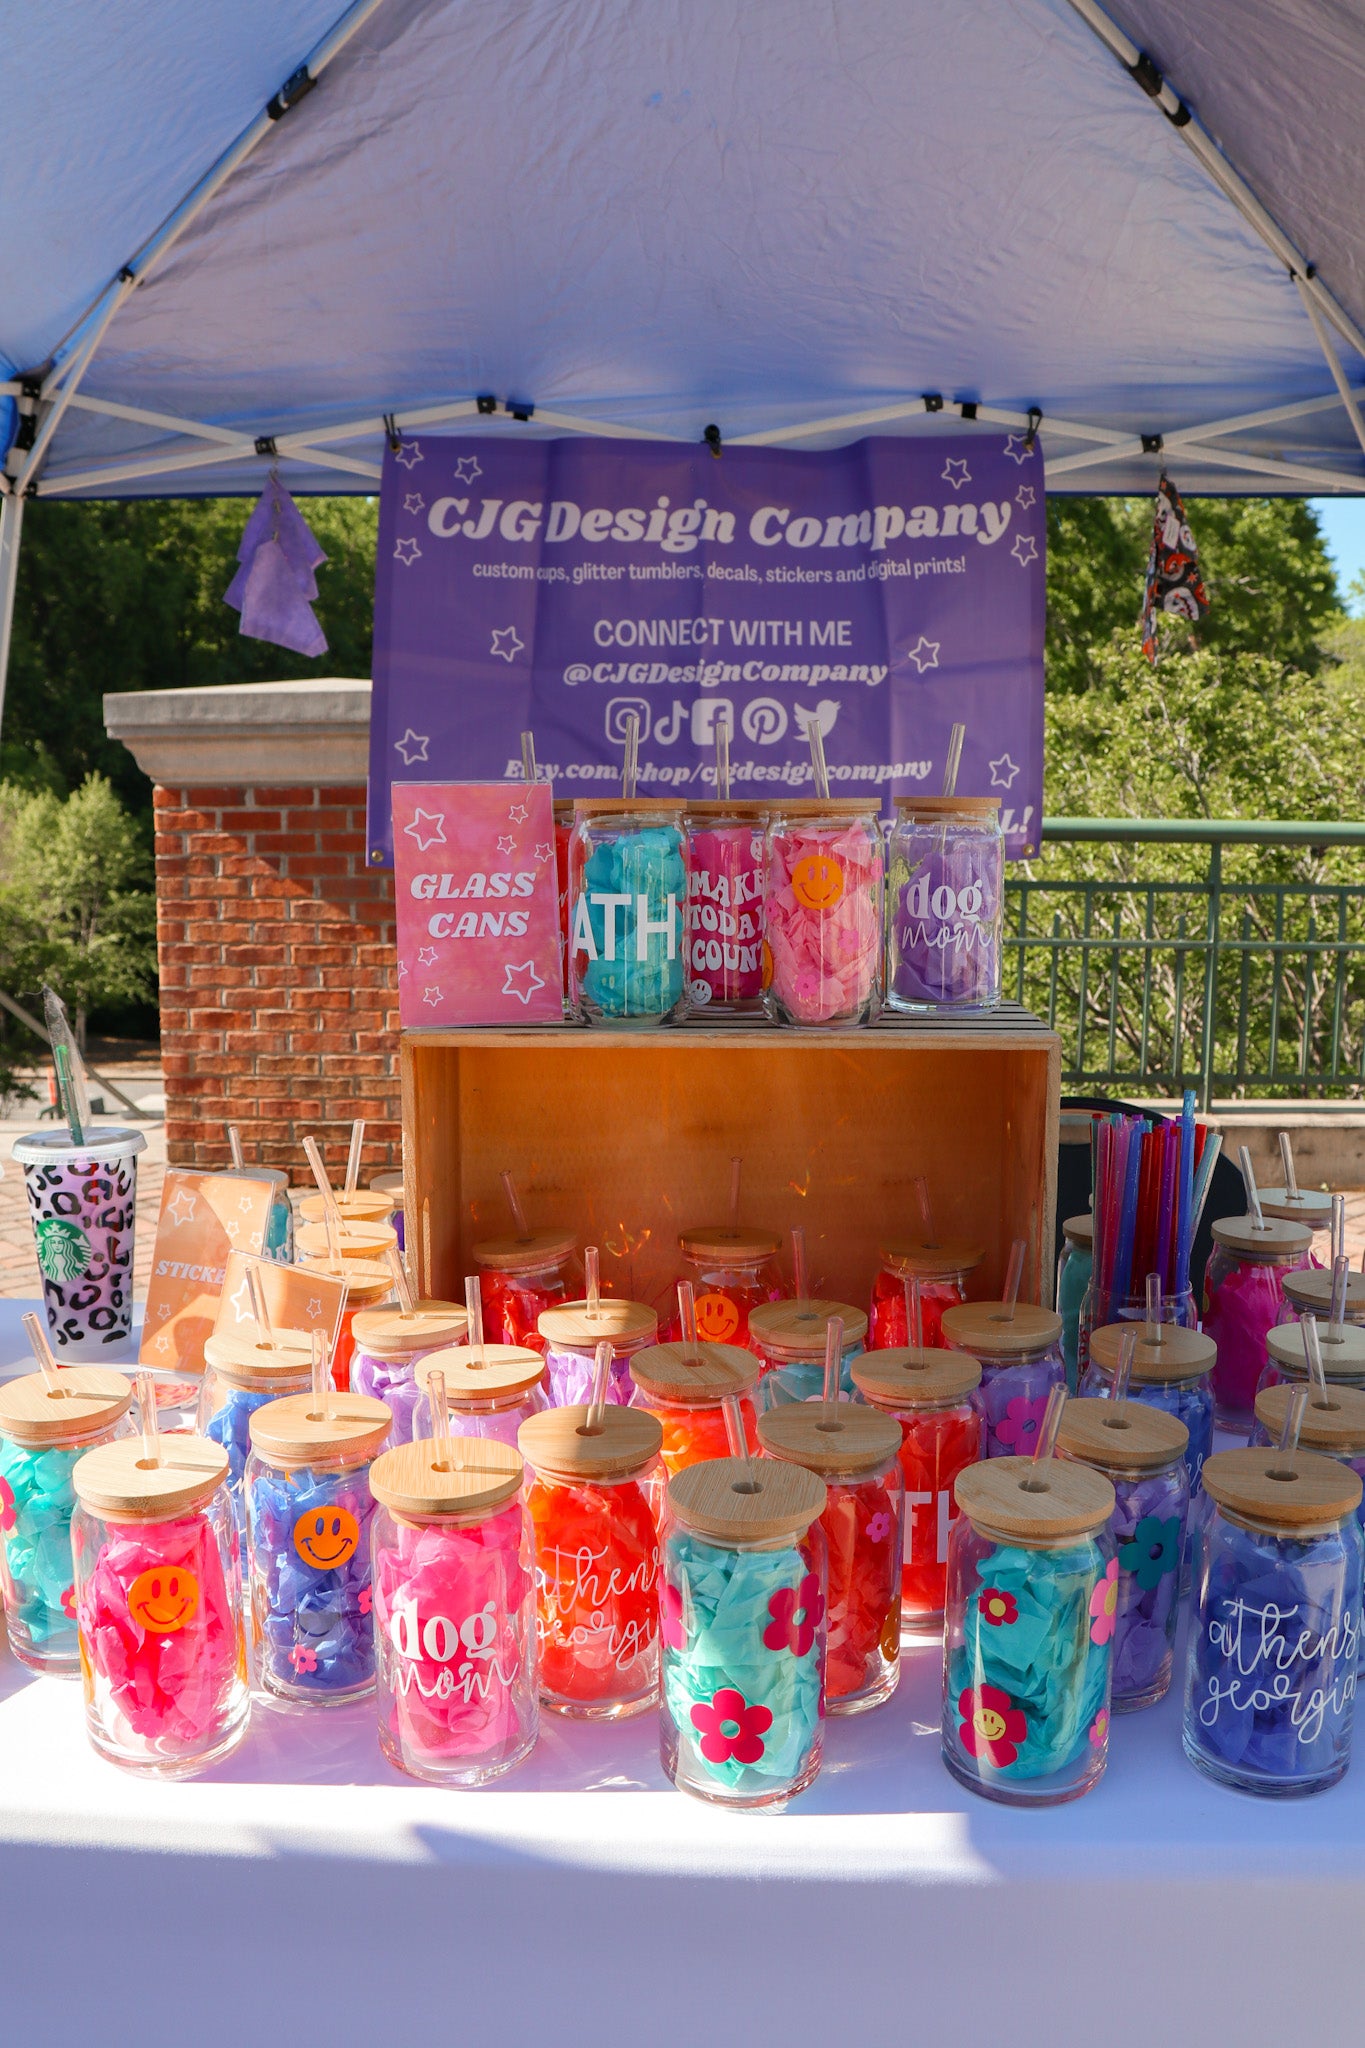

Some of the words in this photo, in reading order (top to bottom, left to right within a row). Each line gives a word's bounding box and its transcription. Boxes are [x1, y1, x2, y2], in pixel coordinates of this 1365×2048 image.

[749, 501, 1012, 551] Company
[473, 562, 533, 580] custom
[536, 566, 571, 584] cups,
[573, 561, 626, 585] glitter
[628, 561, 705, 580] tumblers,
[707, 561, 763, 584] decals,
[765, 564, 833, 583] stickers
[836, 563, 866, 582] and
[868, 557, 912, 580] digital
[914, 556, 966, 579] prints!
[593, 618, 725, 647] CONNECT
[730, 620, 802, 646] WITH
[809, 620, 852, 646] ME
[563, 659, 888, 687] @CJGDesignCompany
[410, 872, 537, 899] GLASS
[906, 872, 983, 923] dog
[428, 911, 530, 939] CANS
[571, 892, 676, 961] ATH
[902, 921, 993, 953] mom
[155, 1260, 226, 1286] STICKE
[390, 1598, 497, 1661] dog
[1209, 1598, 1360, 1675] athens
[390, 1658, 519, 1703] mom
[1200, 1671, 1359, 1744] georgia
